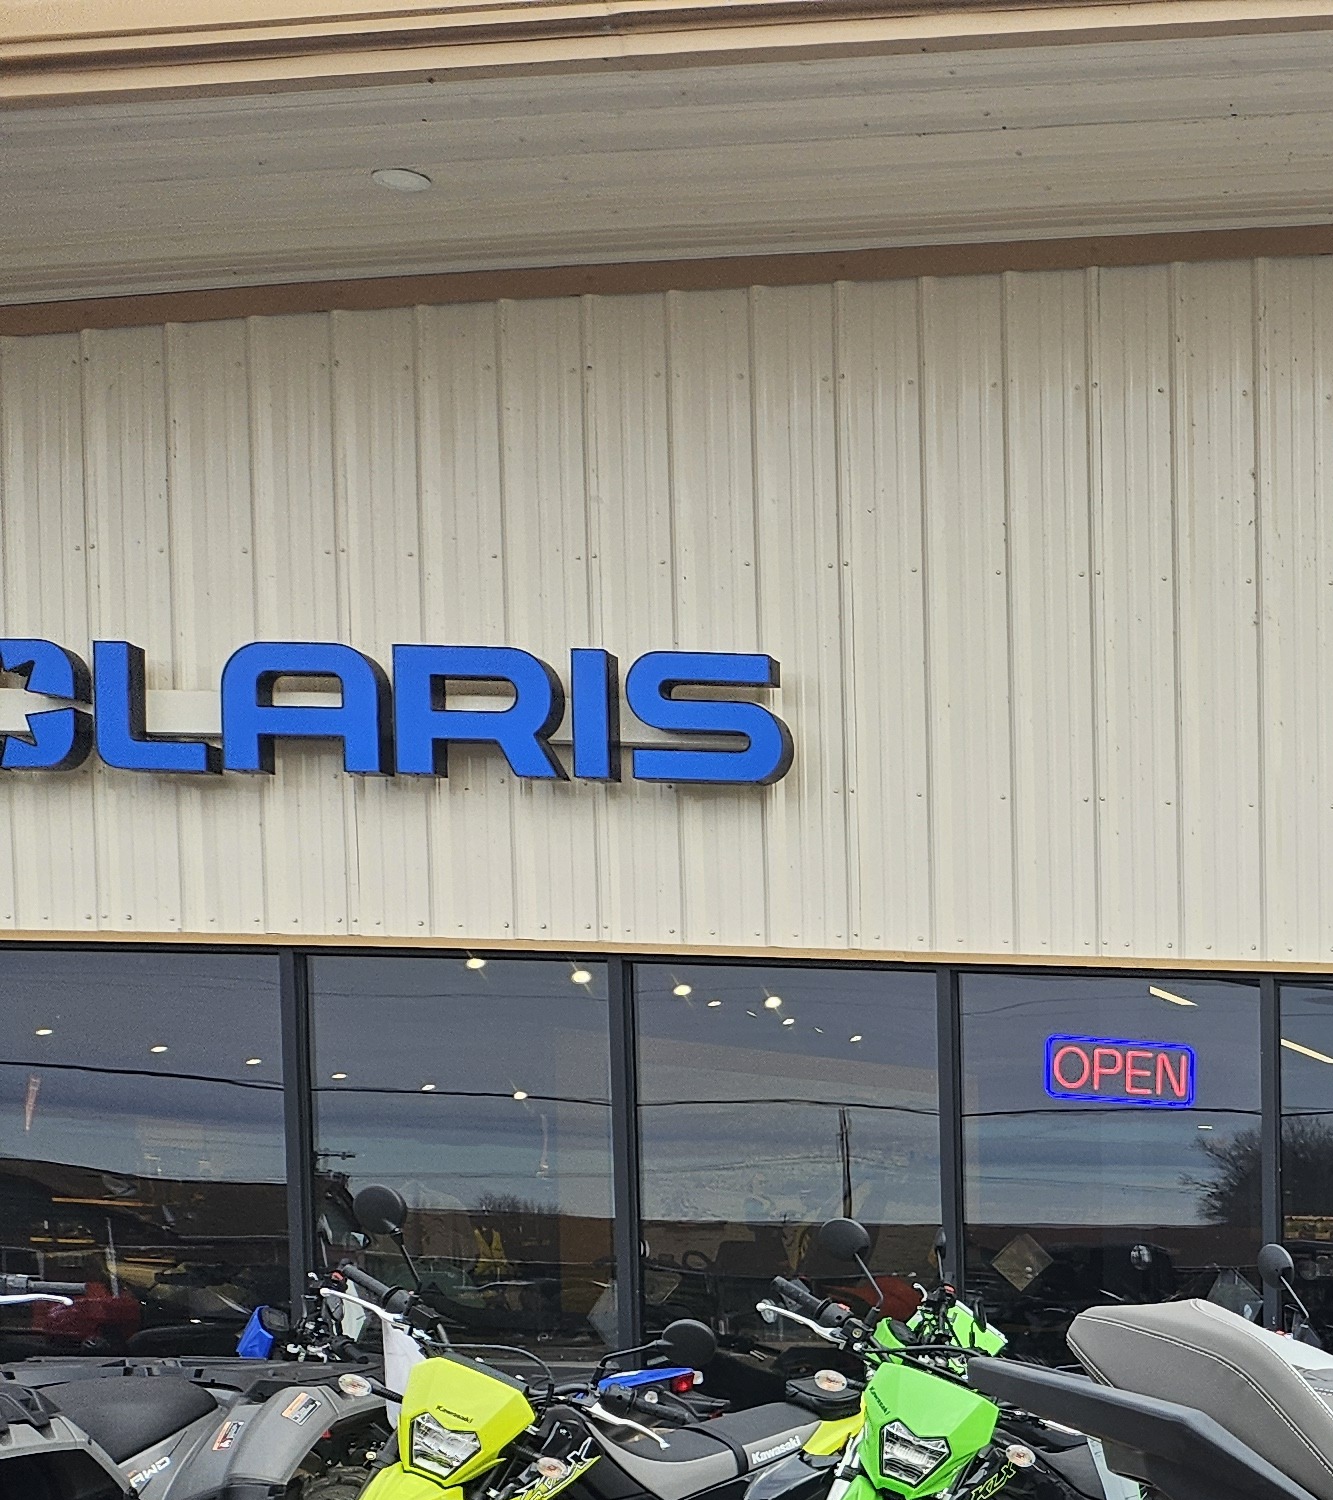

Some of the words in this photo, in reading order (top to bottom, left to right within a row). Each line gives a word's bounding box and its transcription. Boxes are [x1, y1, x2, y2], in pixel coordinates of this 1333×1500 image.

[1053, 1045, 1187, 1097] OPEN
[435, 1405, 474, 1424] Kawasaki
[751, 1435, 801, 1465] Kawasaki
[129, 1456, 171, 1488] AWD
